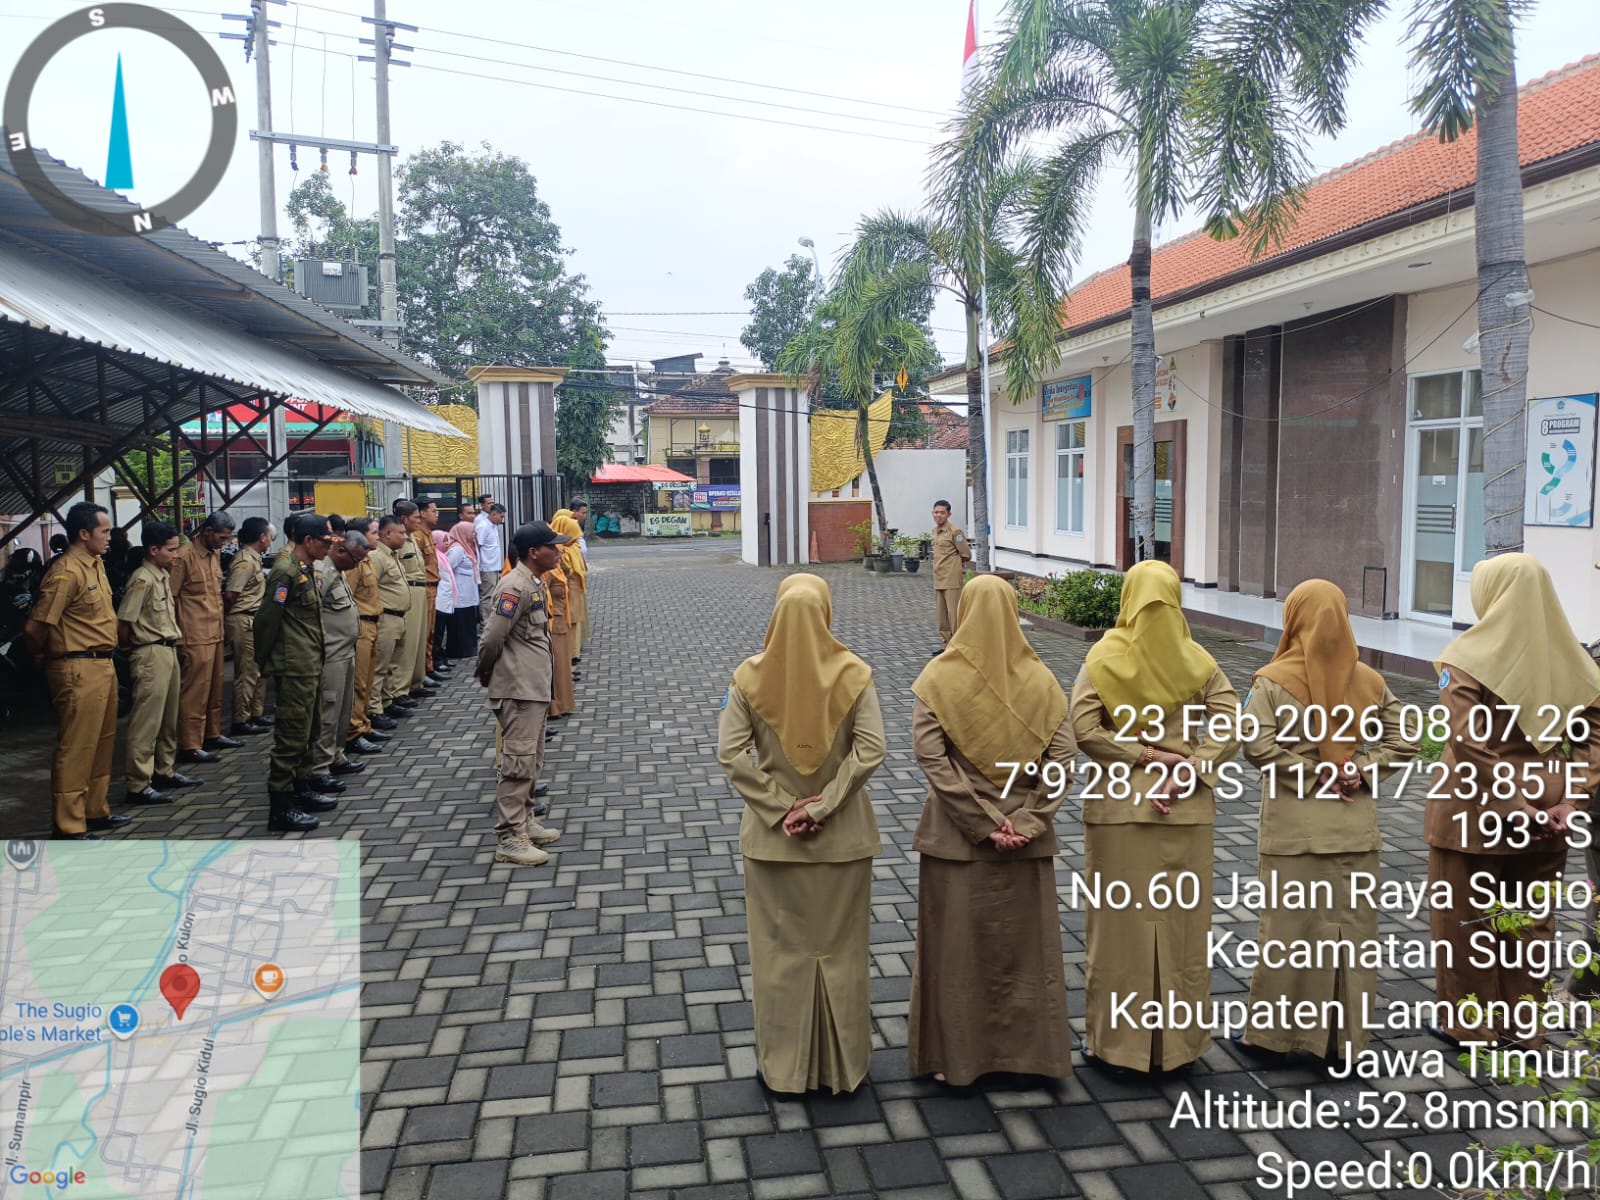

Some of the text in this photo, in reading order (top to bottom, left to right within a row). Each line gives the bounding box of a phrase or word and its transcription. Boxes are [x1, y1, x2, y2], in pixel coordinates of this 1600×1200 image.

[1549, 418, 1579, 429] PROGRAM
[650, 515, 687, 525] ES DEGAN
